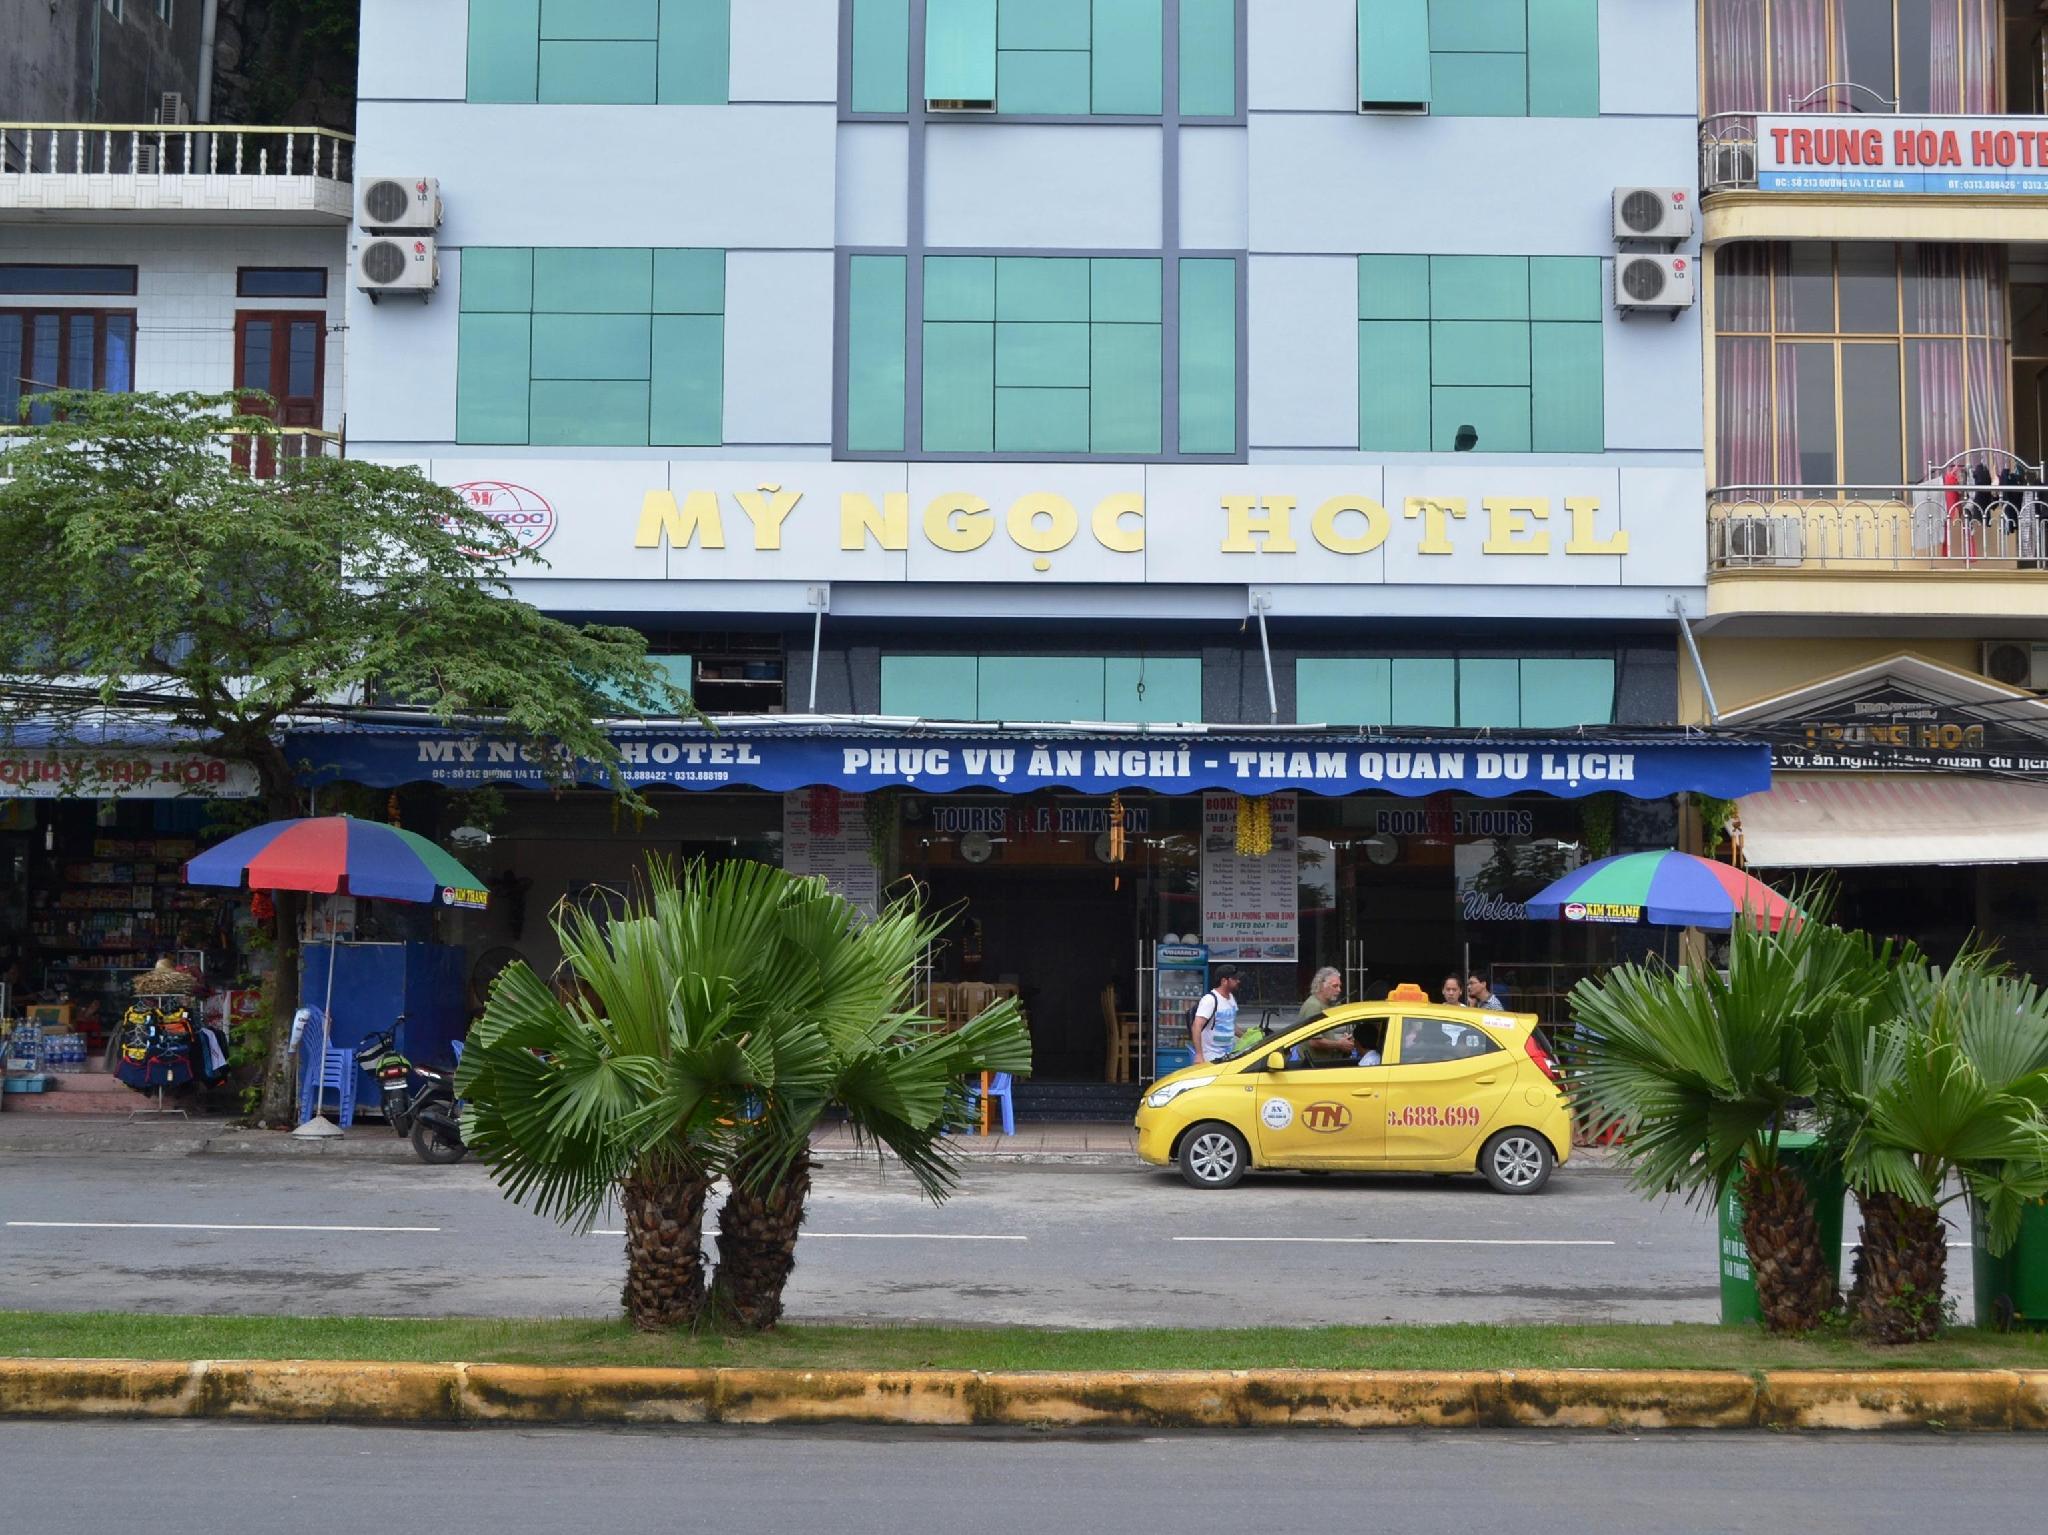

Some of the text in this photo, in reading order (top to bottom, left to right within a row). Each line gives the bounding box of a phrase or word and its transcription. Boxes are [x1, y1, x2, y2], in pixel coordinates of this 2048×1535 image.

[1770, 128, 2048, 167] TRUNG HOA HOTE
[635, 482, 1629, 572] MỸ NGỌC HOTEL
[418, 736, 481, 763] MỸ
[619, 742, 761, 765] HOTEL
[1916, 723, 1985, 750] HOA
[515, 770, 527, 779] 1/4
[843, 748, 950, 783] PHỤC
[962, 748, 1016, 783] VỤ
[1027, 744, 1083, 777] ĂN
[1094, 742, 1192, 777] NGHỈ
[1228, 751, 1348, 779] THAM
[1358, 752, 1466, 782] QUAN
[1476, 753, 1529, 780] DU
[1541, 753, 1635, 788] LỊCH
[1468, 808, 1534, 836] TOURS
[1585, 903, 1640, 918] KIM THANH
[1387, 1106, 1481, 1127] 3.688.699
